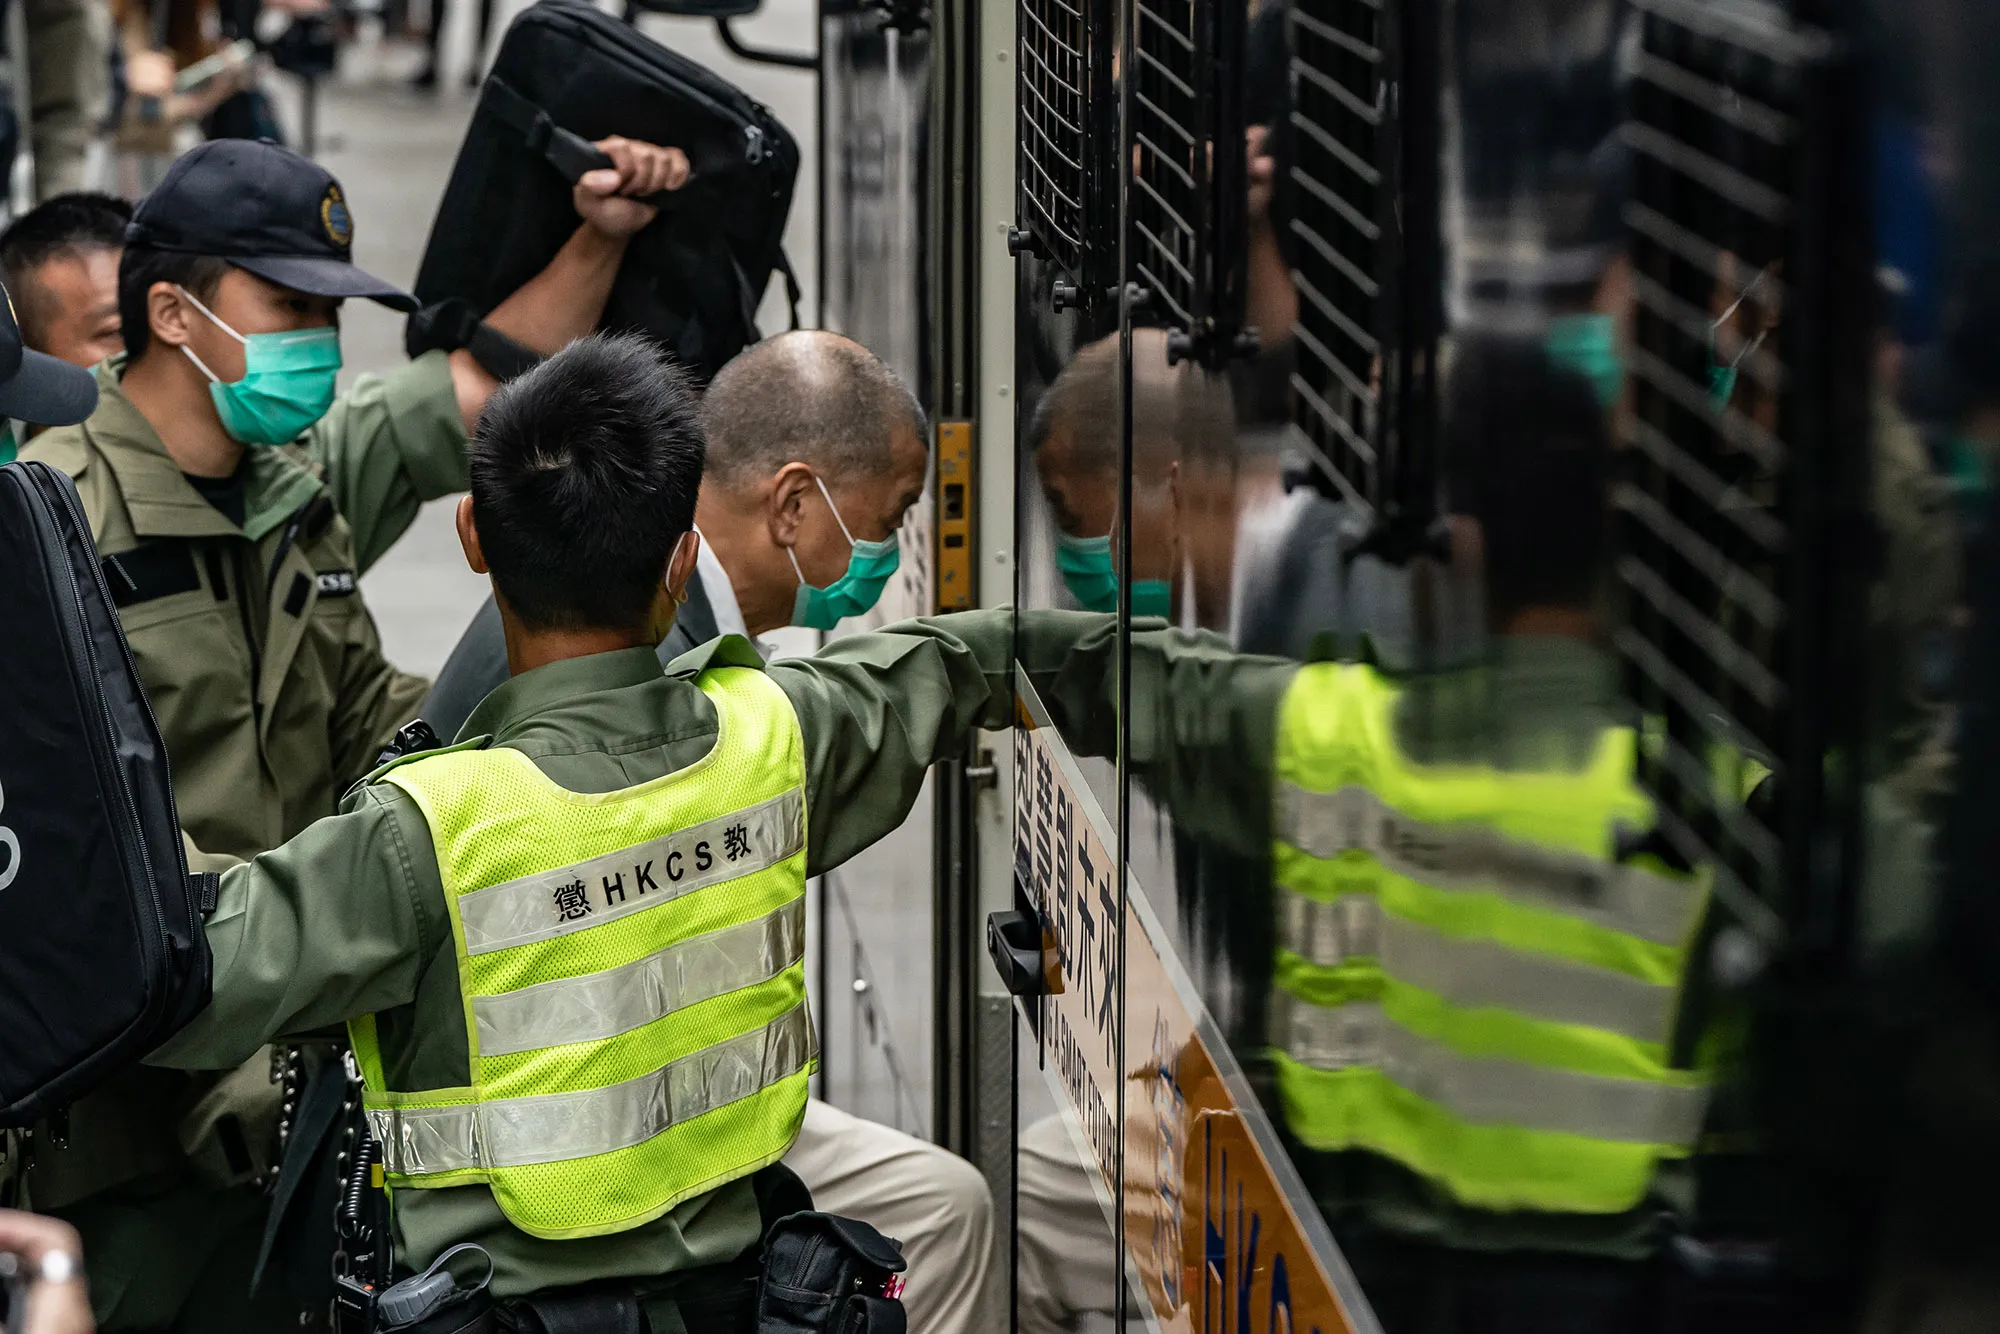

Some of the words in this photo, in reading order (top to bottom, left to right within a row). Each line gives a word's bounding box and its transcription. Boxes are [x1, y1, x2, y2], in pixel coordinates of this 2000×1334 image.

[553, 879, 592, 922] 懲
[602, 841, 713, 906] HKCS
[723, 823, 752, 862] 教
[1061, 1013, 1086, 1122] SMART
[1088, 1070, 1116, 1193] FUTURE
